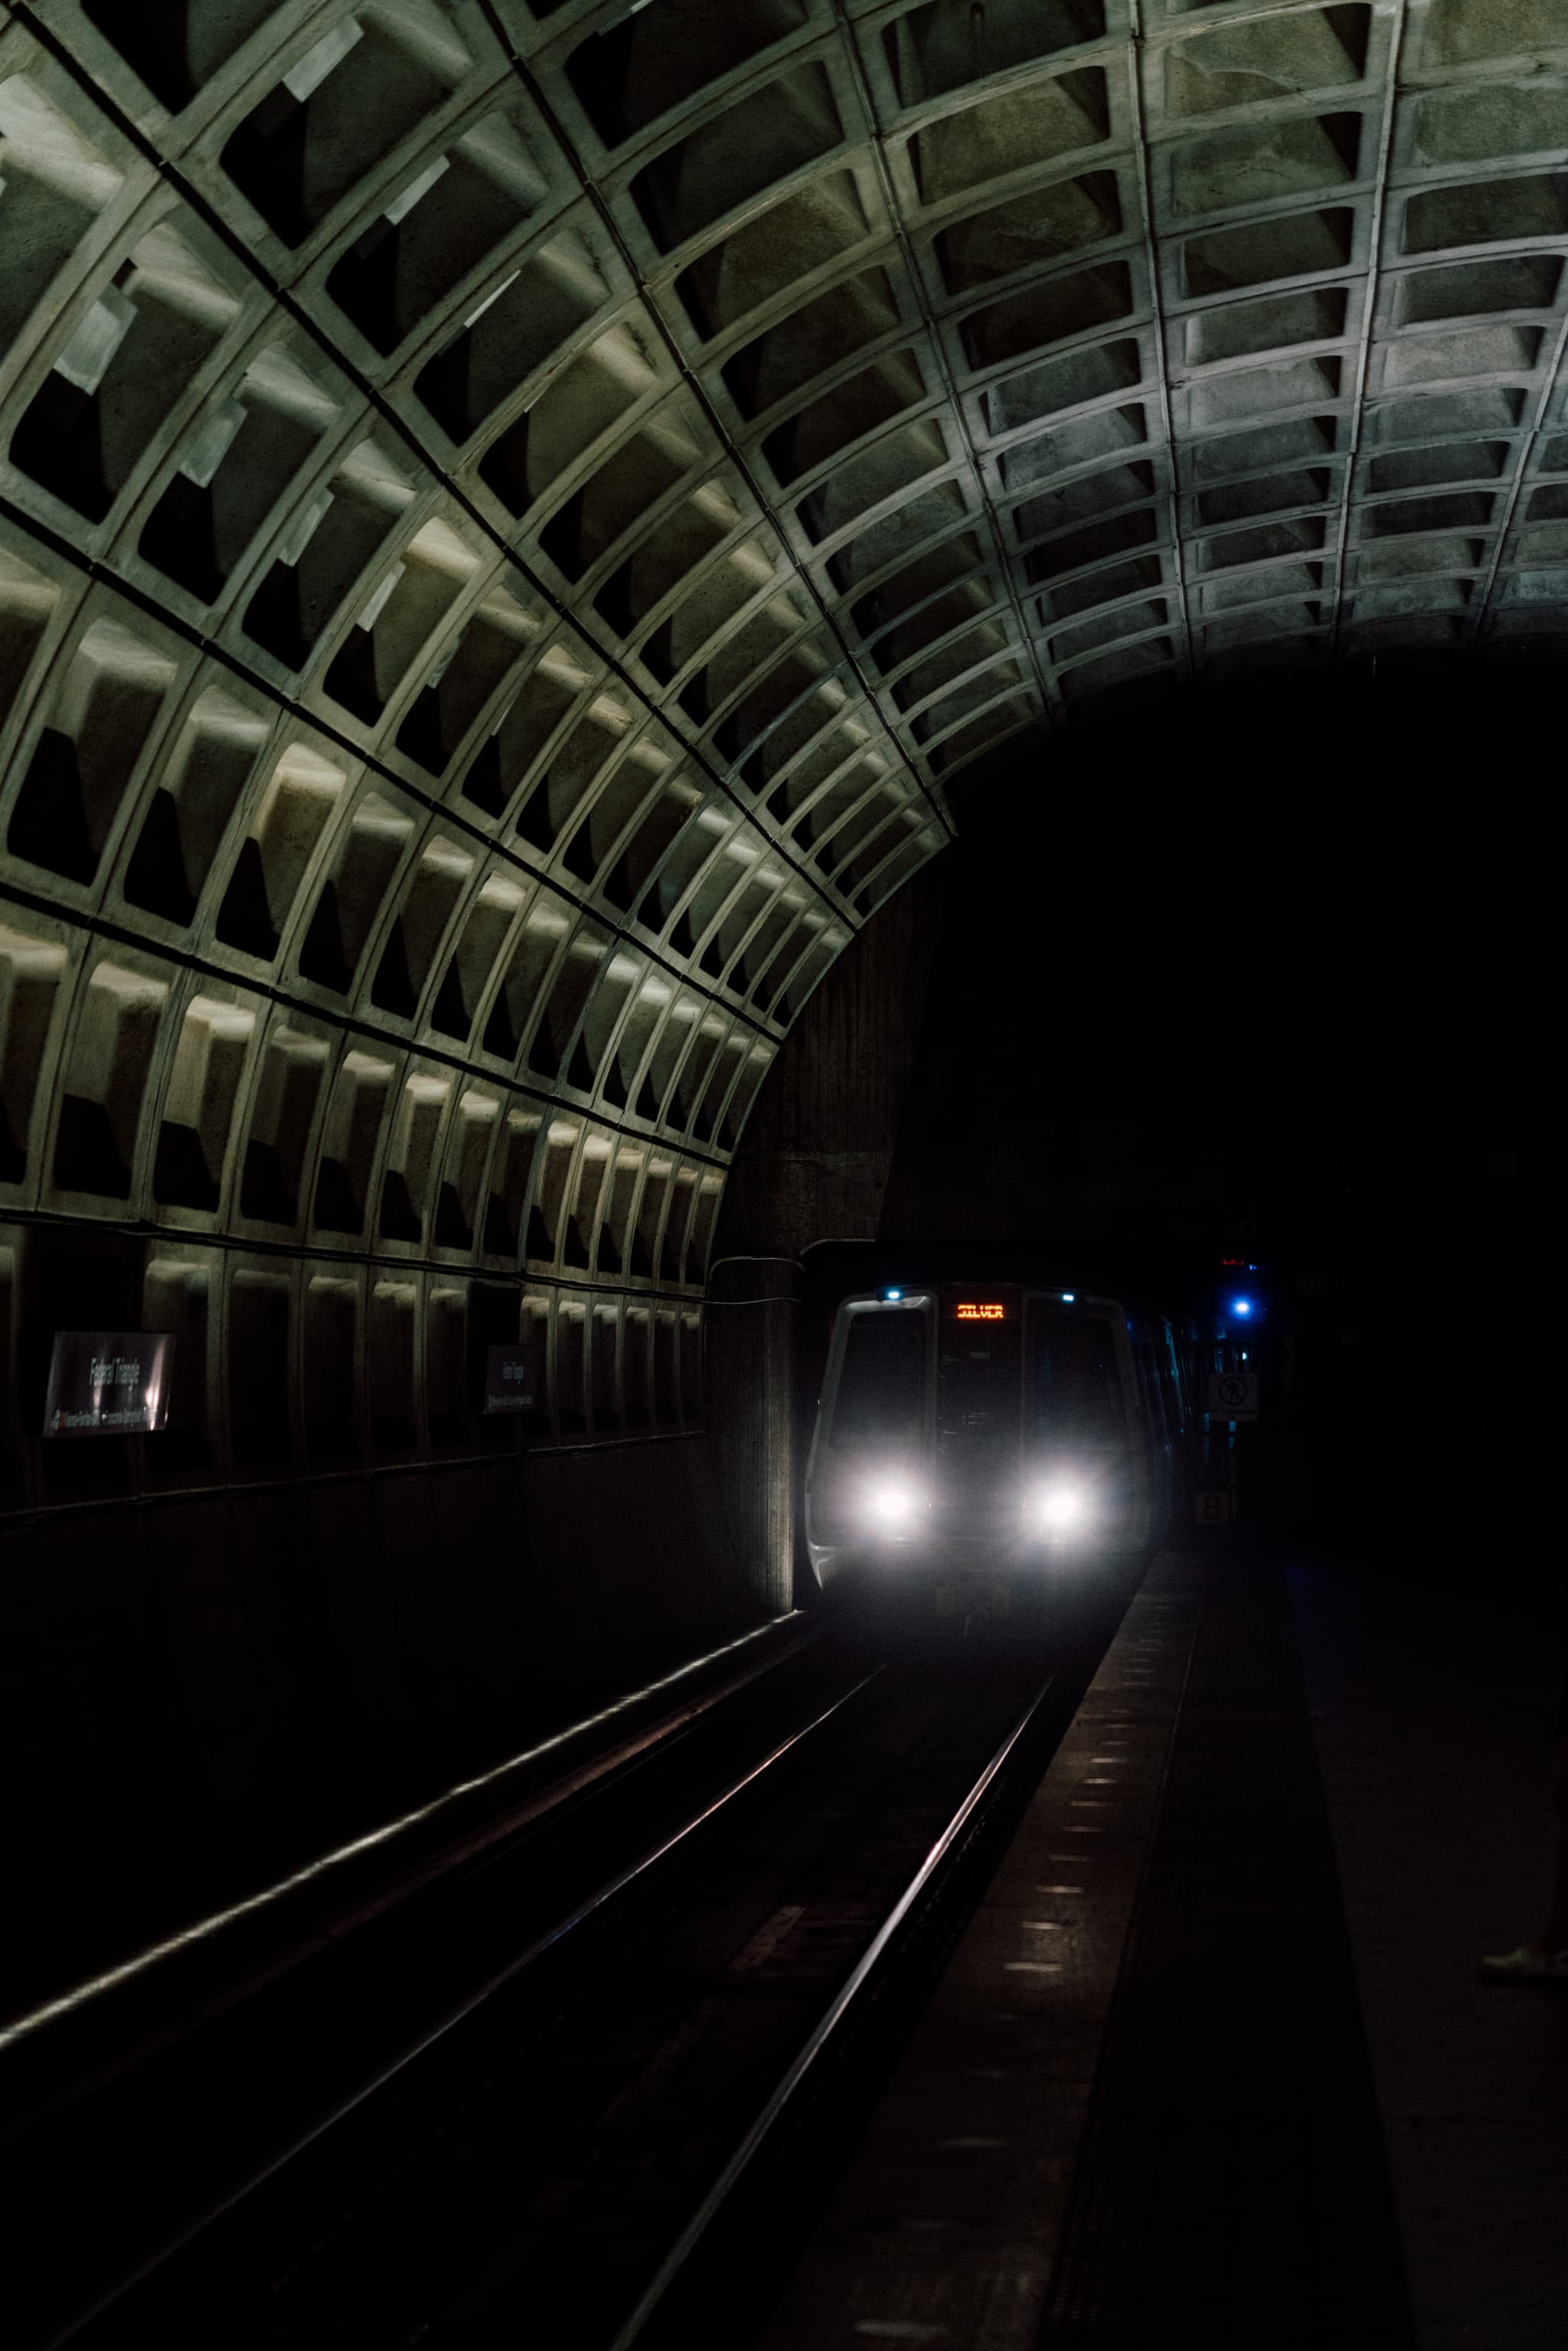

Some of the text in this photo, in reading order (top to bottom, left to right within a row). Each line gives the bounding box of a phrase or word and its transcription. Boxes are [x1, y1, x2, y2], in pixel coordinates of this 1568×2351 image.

[957, 1304, 1004, 1319] SILVER
[89, 1357, 140, 1391] Federal Triangle
